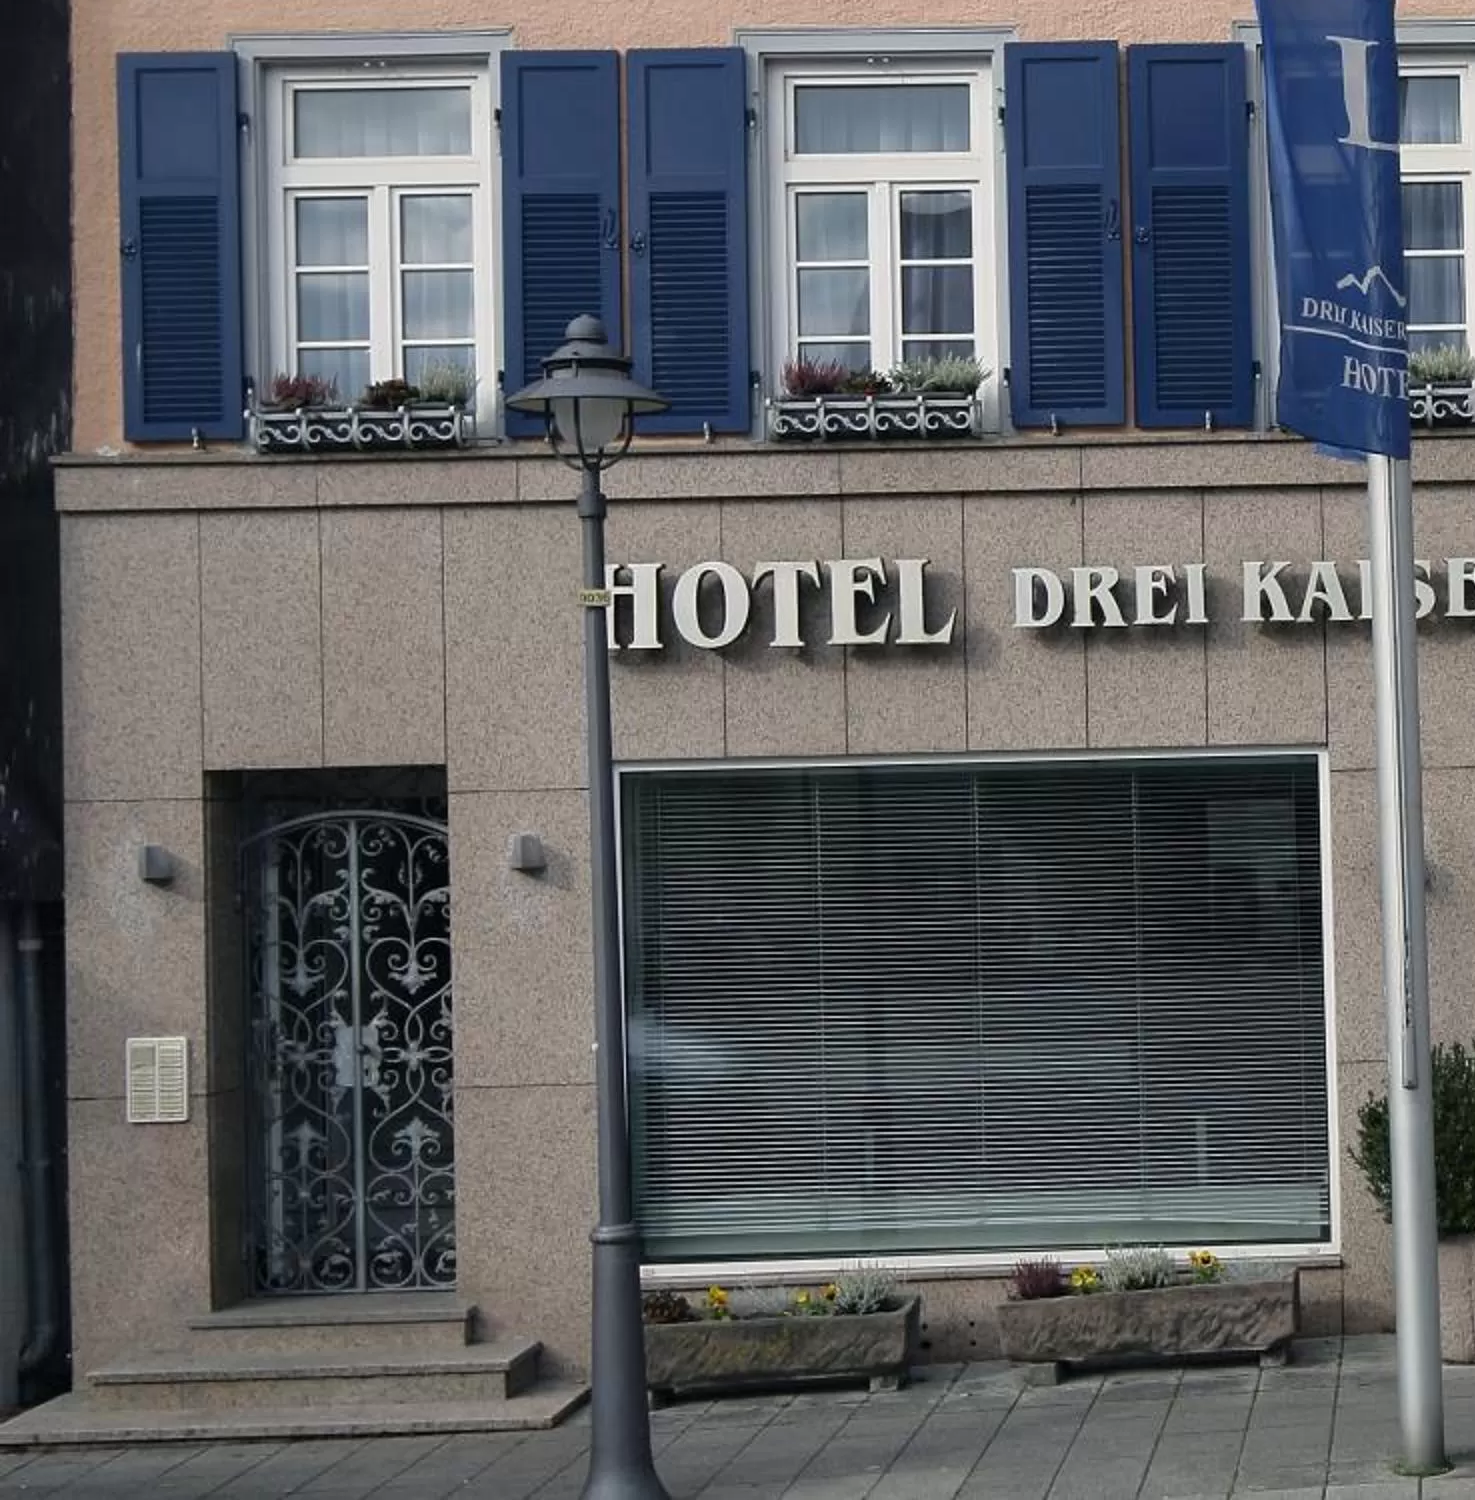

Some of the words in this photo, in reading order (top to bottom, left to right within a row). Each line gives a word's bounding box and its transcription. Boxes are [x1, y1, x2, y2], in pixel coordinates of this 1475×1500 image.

[1340, 355, 1409, 400] HOTE
[605, 557, 958, 650] HOTEL
[1012, 562, 1209, 628] DREI
